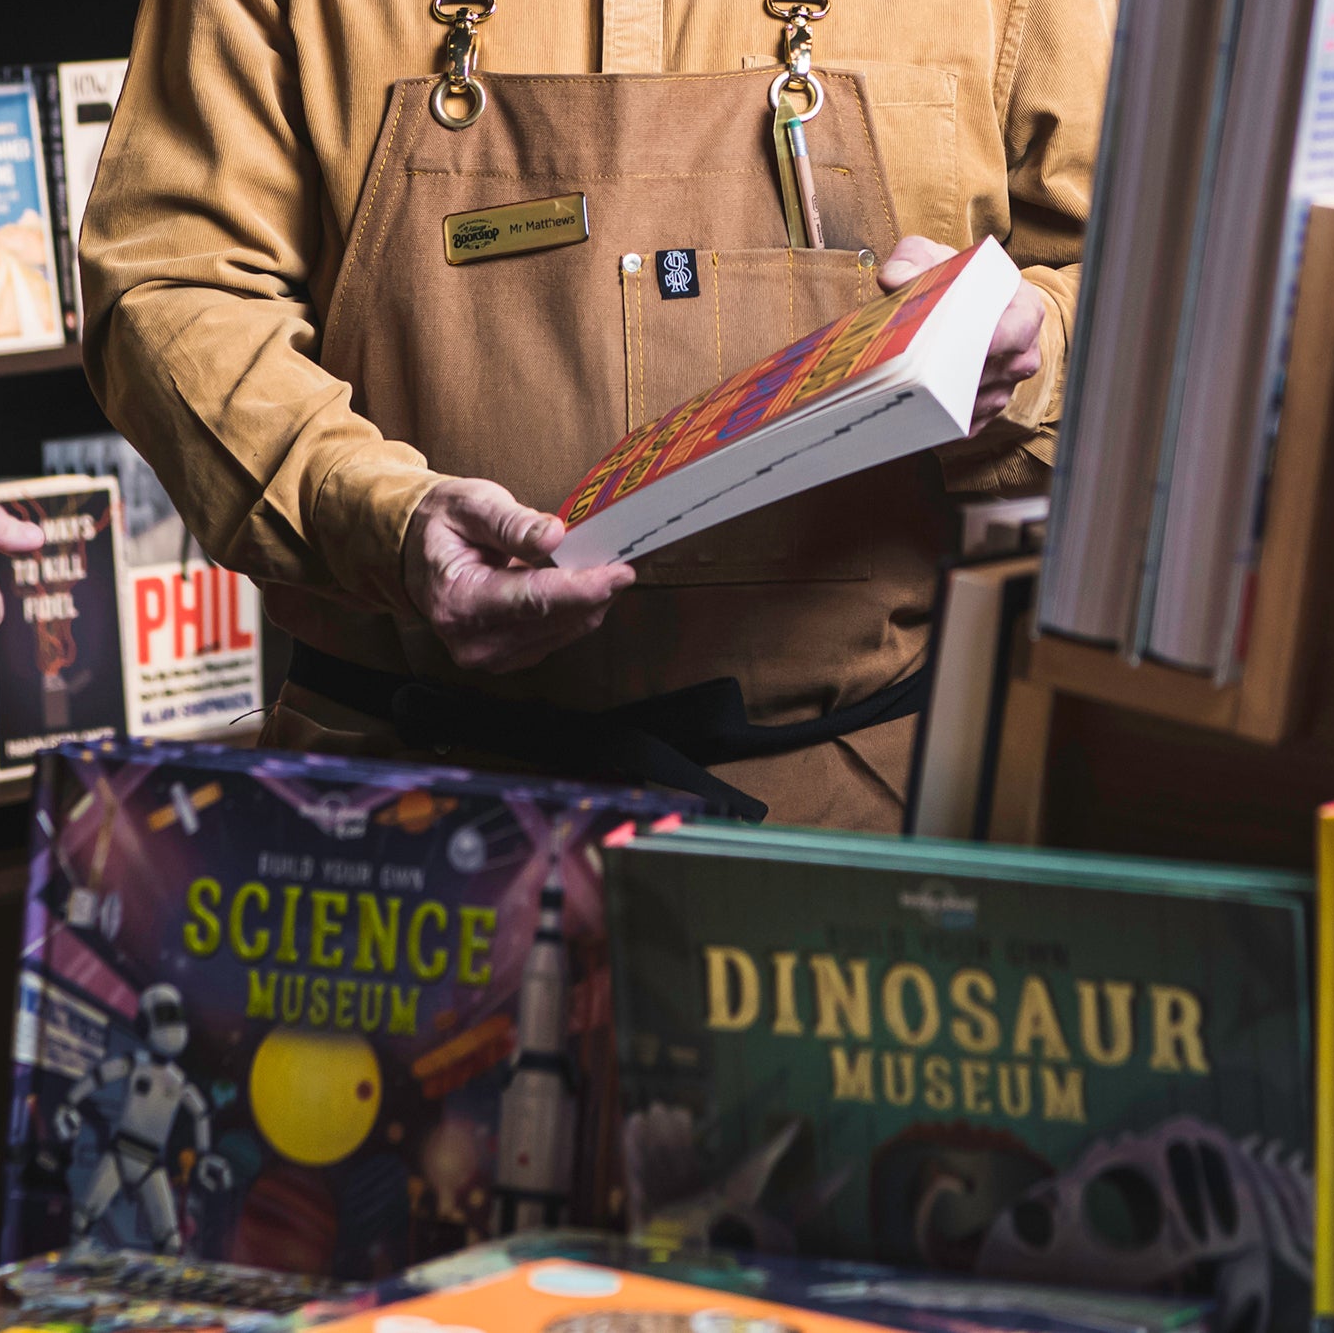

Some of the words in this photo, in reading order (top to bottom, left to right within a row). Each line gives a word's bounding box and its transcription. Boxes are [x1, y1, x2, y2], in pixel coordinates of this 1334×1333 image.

[452, 228, 500, 249] BOOKSHOP
[509, 223, 523, 235] Mr
[526, 215, 576, 232] Matthews
[11, 557, 40, 585] TO
[41, 553, 87, 581] KILL
[134, 564, 253, 666] PHIL
[183, 876, 499, 986] SCIENCE
[245, 969, 423, 1037] MUSEUM
[703, 943, 1210, 1076] DINOSAUR
[830, 1044, 1088, 1124] MUSEUM
